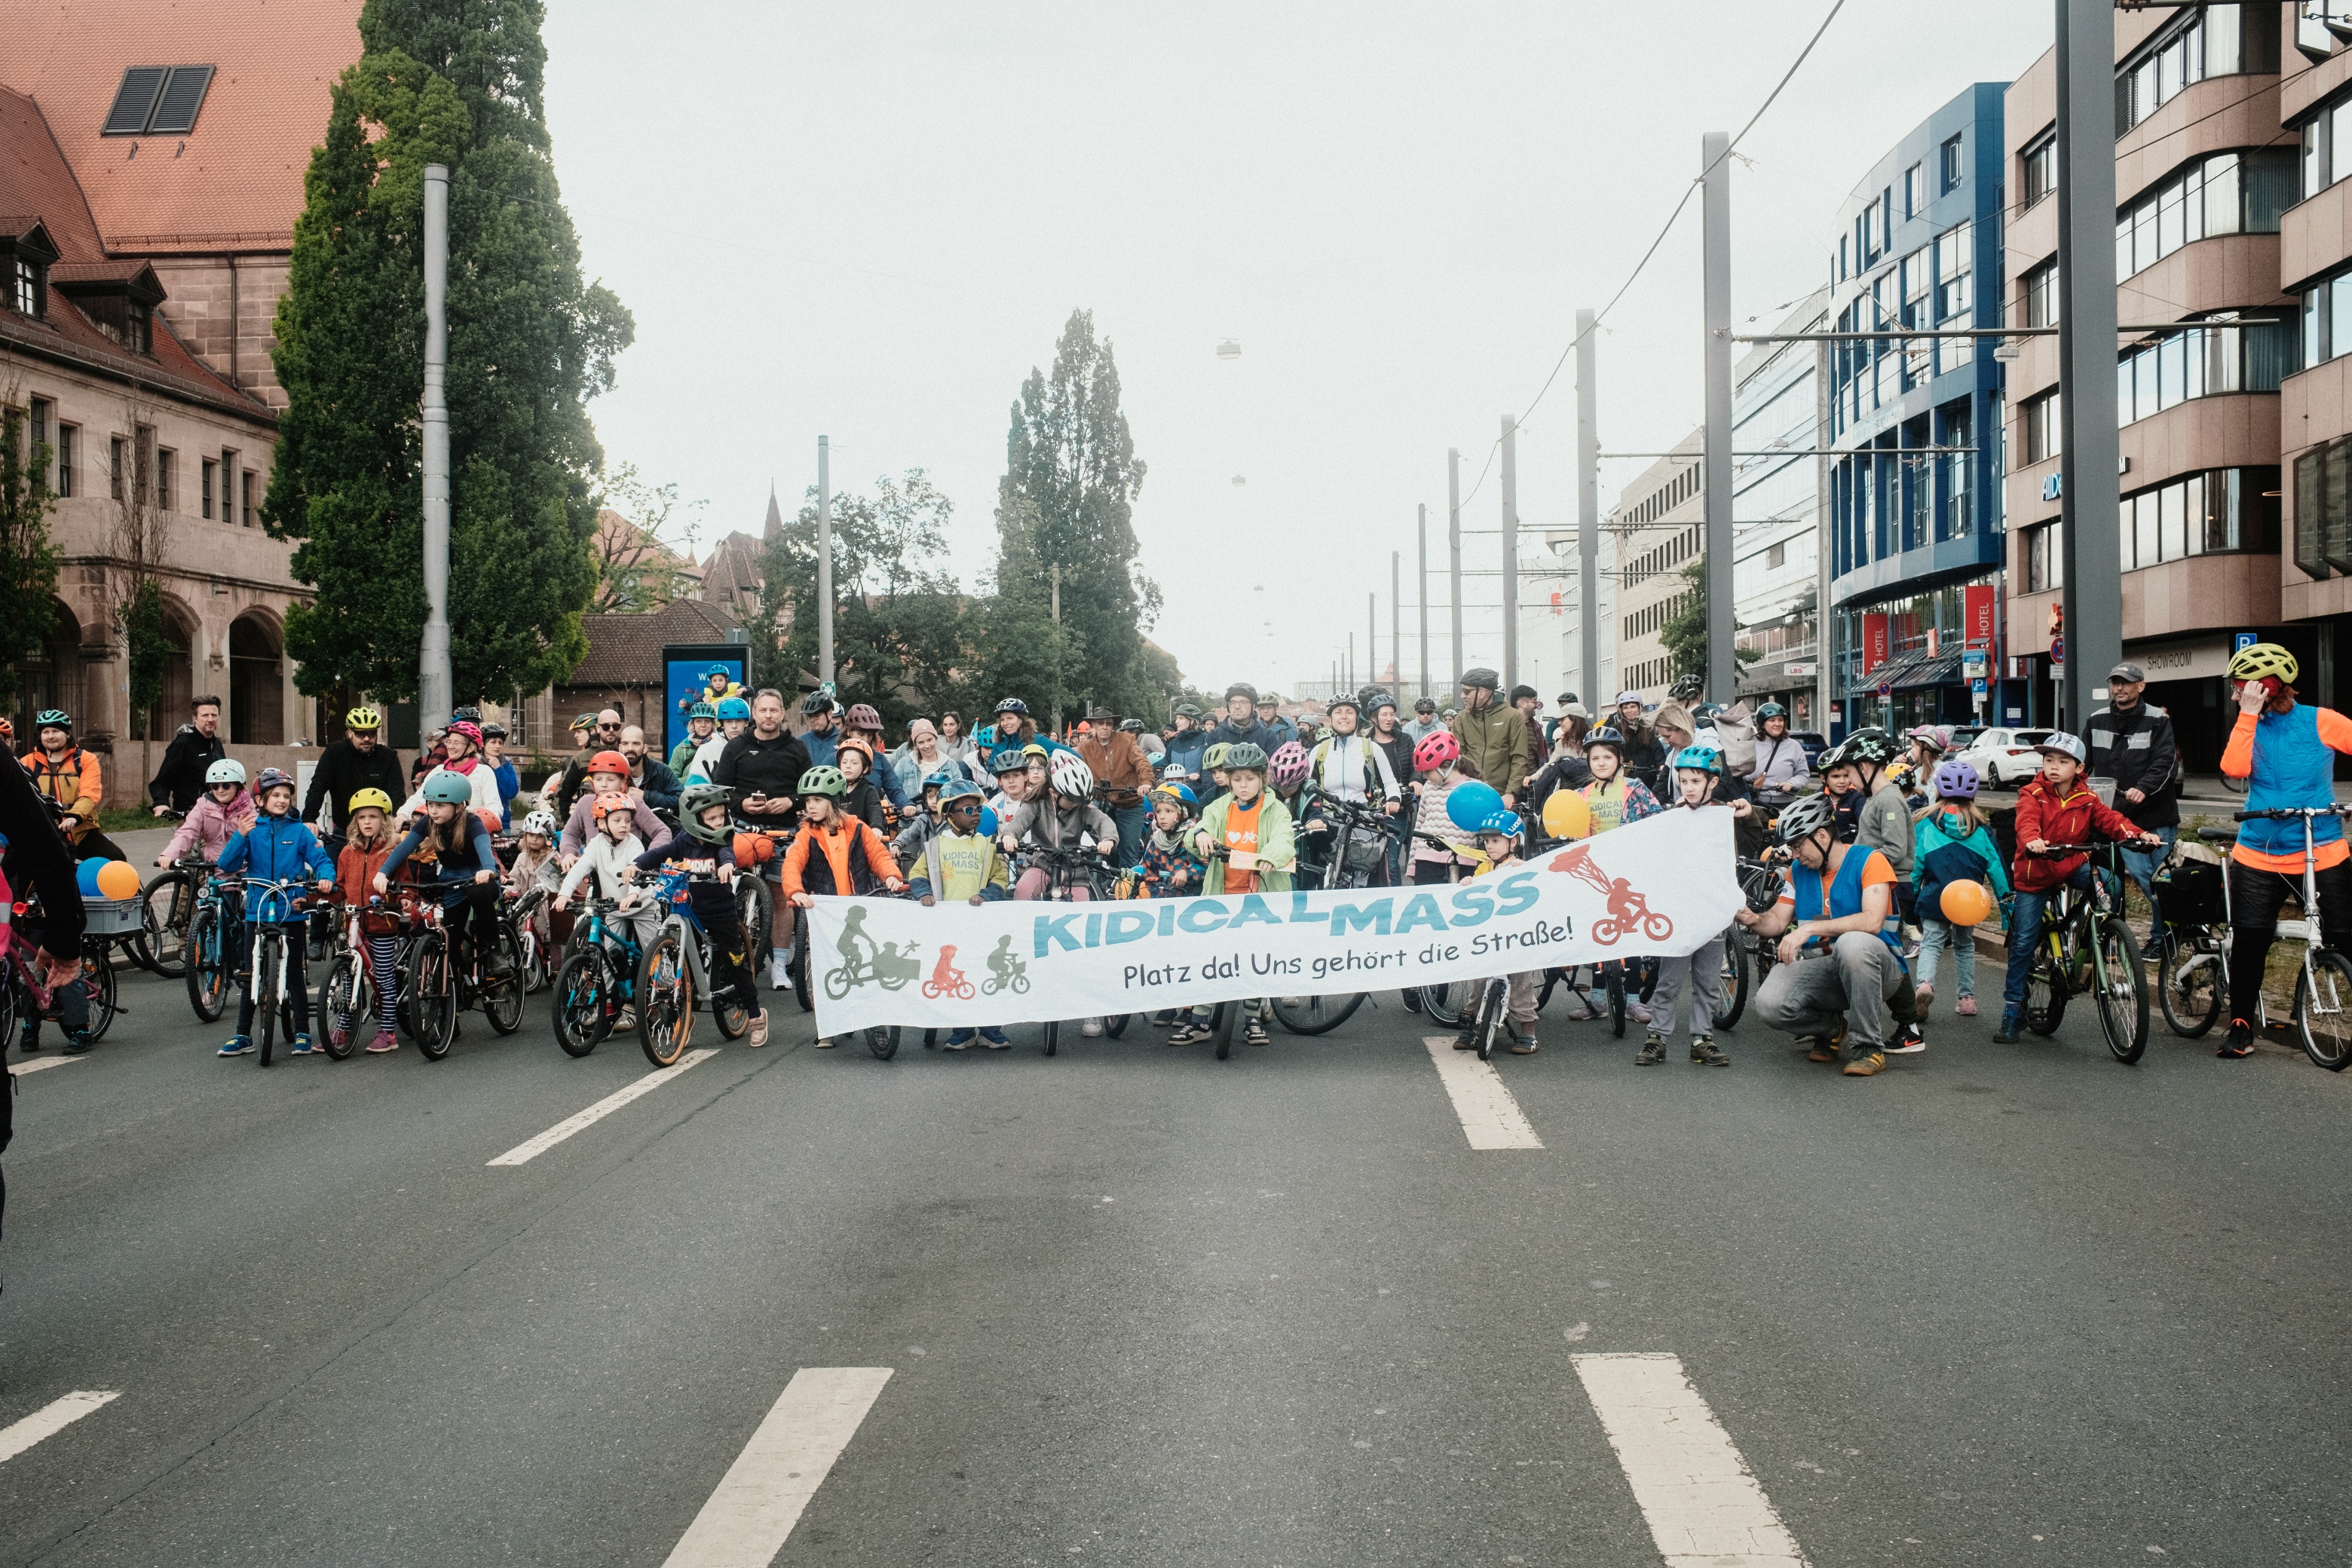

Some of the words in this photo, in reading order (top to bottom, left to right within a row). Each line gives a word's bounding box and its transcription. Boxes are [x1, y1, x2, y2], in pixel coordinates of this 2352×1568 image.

[1980, 603, 1989, 636] HOTEL
[1875, 628, 1884, 657] HOTEL
[2147, 651, 2192, 670] SHOWROOM
[1590, 800, 1623, 812] KIDICAL
[942, 851, 979, 861] KIDICAL
[951, 860, 979, 869] MASS
[1034, 890, 1331, 958] KIDICAL
[1330, 871, 1540, 936] MASS
[1124, 963, 1191, 989] Platz
[1202, 953, 1240, 980] da!
[1251, 953, 1302, 975] Uns
[1312, 948, 1407, 979] gehört
[1419, 942, 1459, 964] die
[1471, 915, 1574, 955] Straße!
